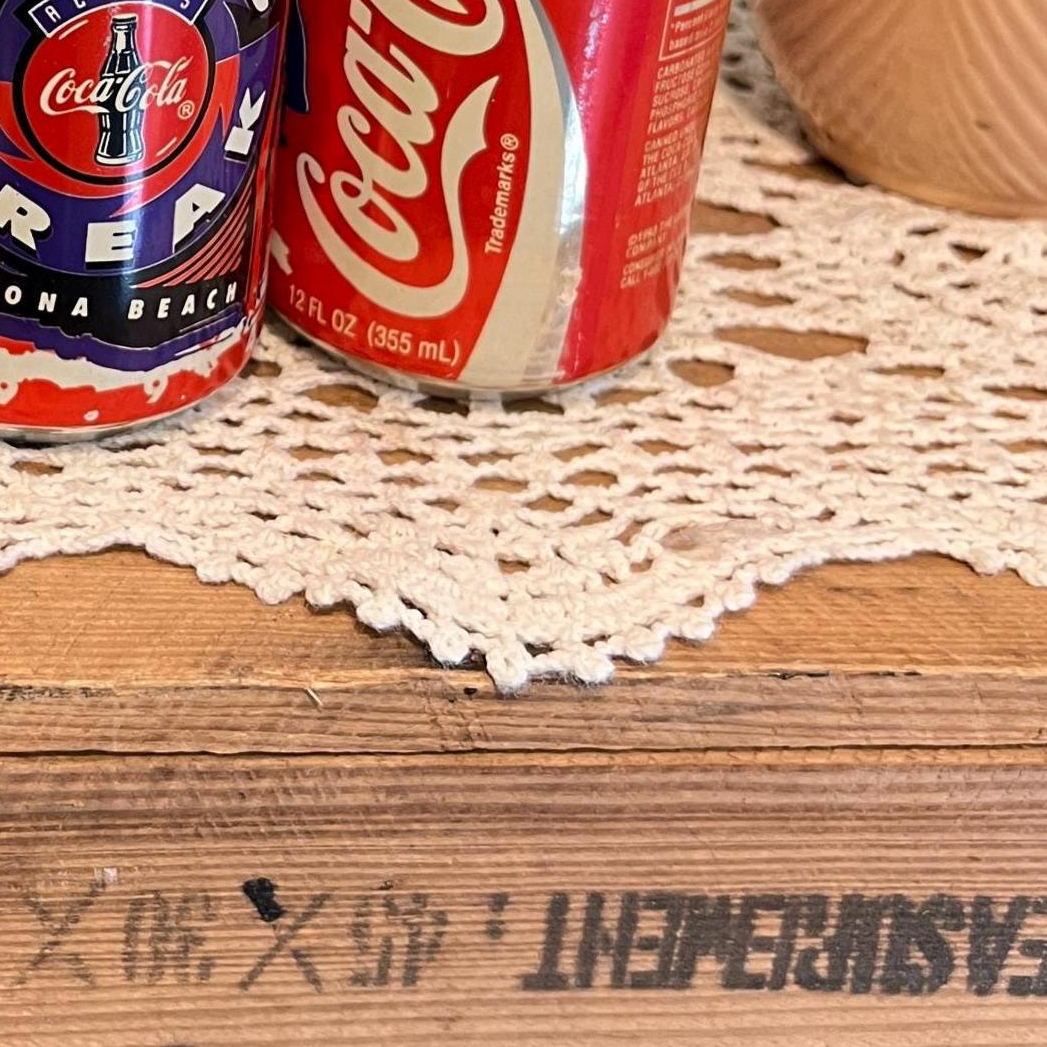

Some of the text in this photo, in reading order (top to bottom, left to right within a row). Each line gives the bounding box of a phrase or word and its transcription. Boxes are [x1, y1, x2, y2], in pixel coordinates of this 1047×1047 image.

[39, 54, 194, 116] Coca-Cola
[127, 281, 238, 320] BEACH
[289, 283, 460, 367] 12 FL OZ (355 mL)
